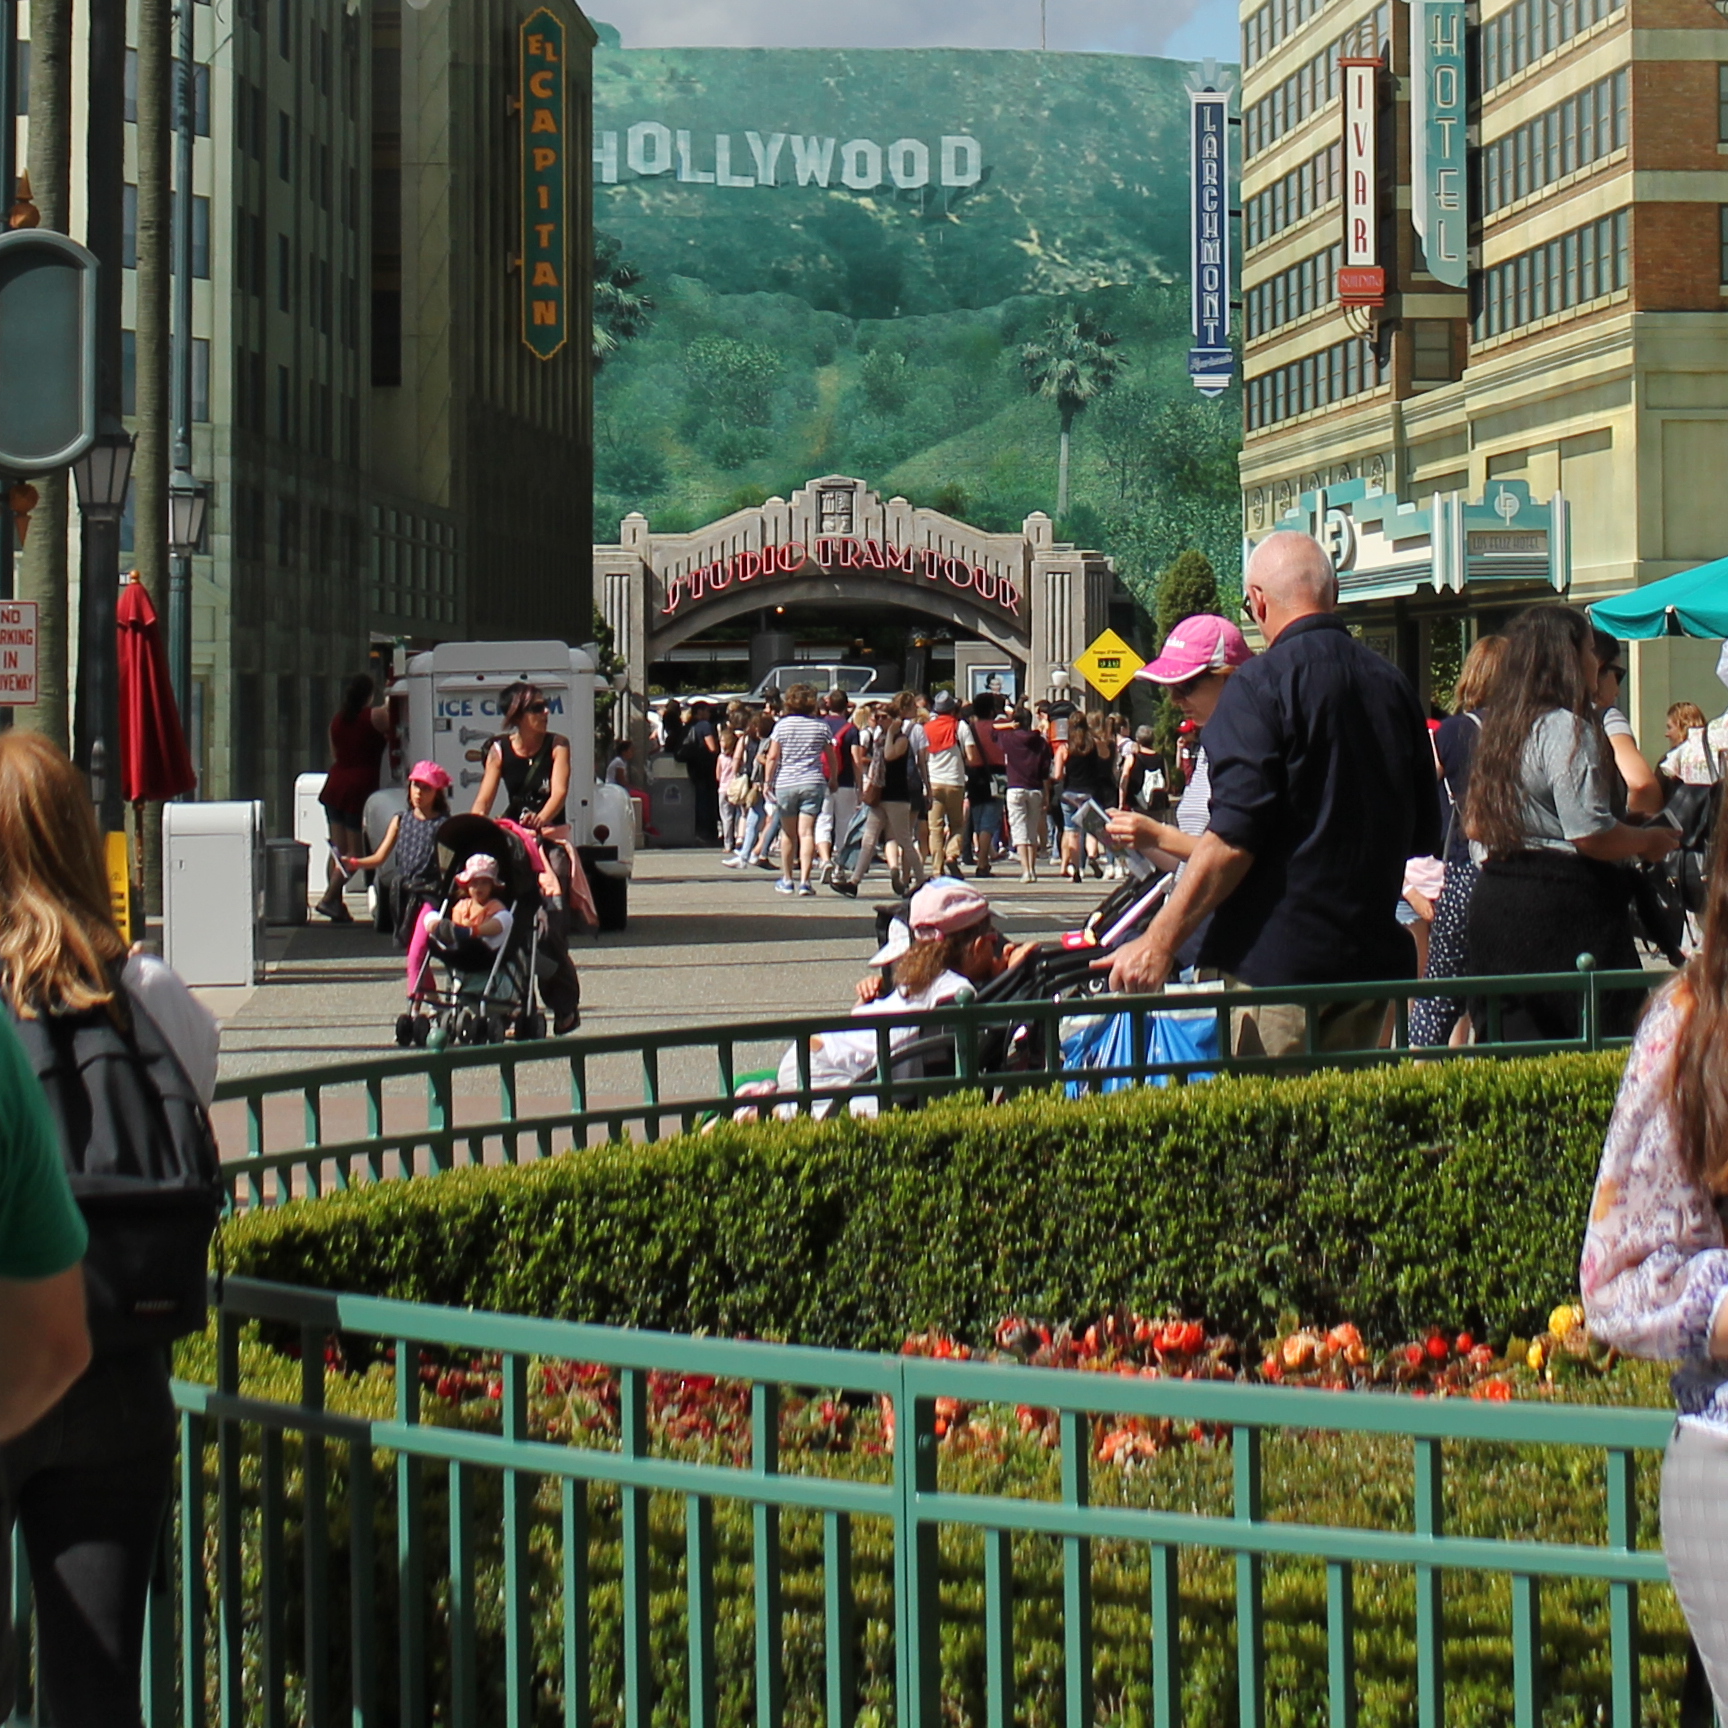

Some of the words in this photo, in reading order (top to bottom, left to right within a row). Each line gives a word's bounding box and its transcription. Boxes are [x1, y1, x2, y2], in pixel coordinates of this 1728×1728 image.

[527, 34, 559, 62] EL
[592, 120, 982, 190] HOLLYWOOD
[1353, 74, 1368, 254] IVAR
[1430, 14, 1460, 262] HOTEL
[529, 70, 559, 325] CAPITAN
[1201, 106, 1221, 345] LARCHMONT
[661, 540, 808, 614] STUDIO
[814, 537, 914, 574] TRAM
[921, 548, 1021, 617] TOUR
[1512, 536, 1540, 549] HOTEL
[0, 609, 21, 624] NO
[3, 651, 18, 669] IN
[438, 698, 473, 717] ICE
